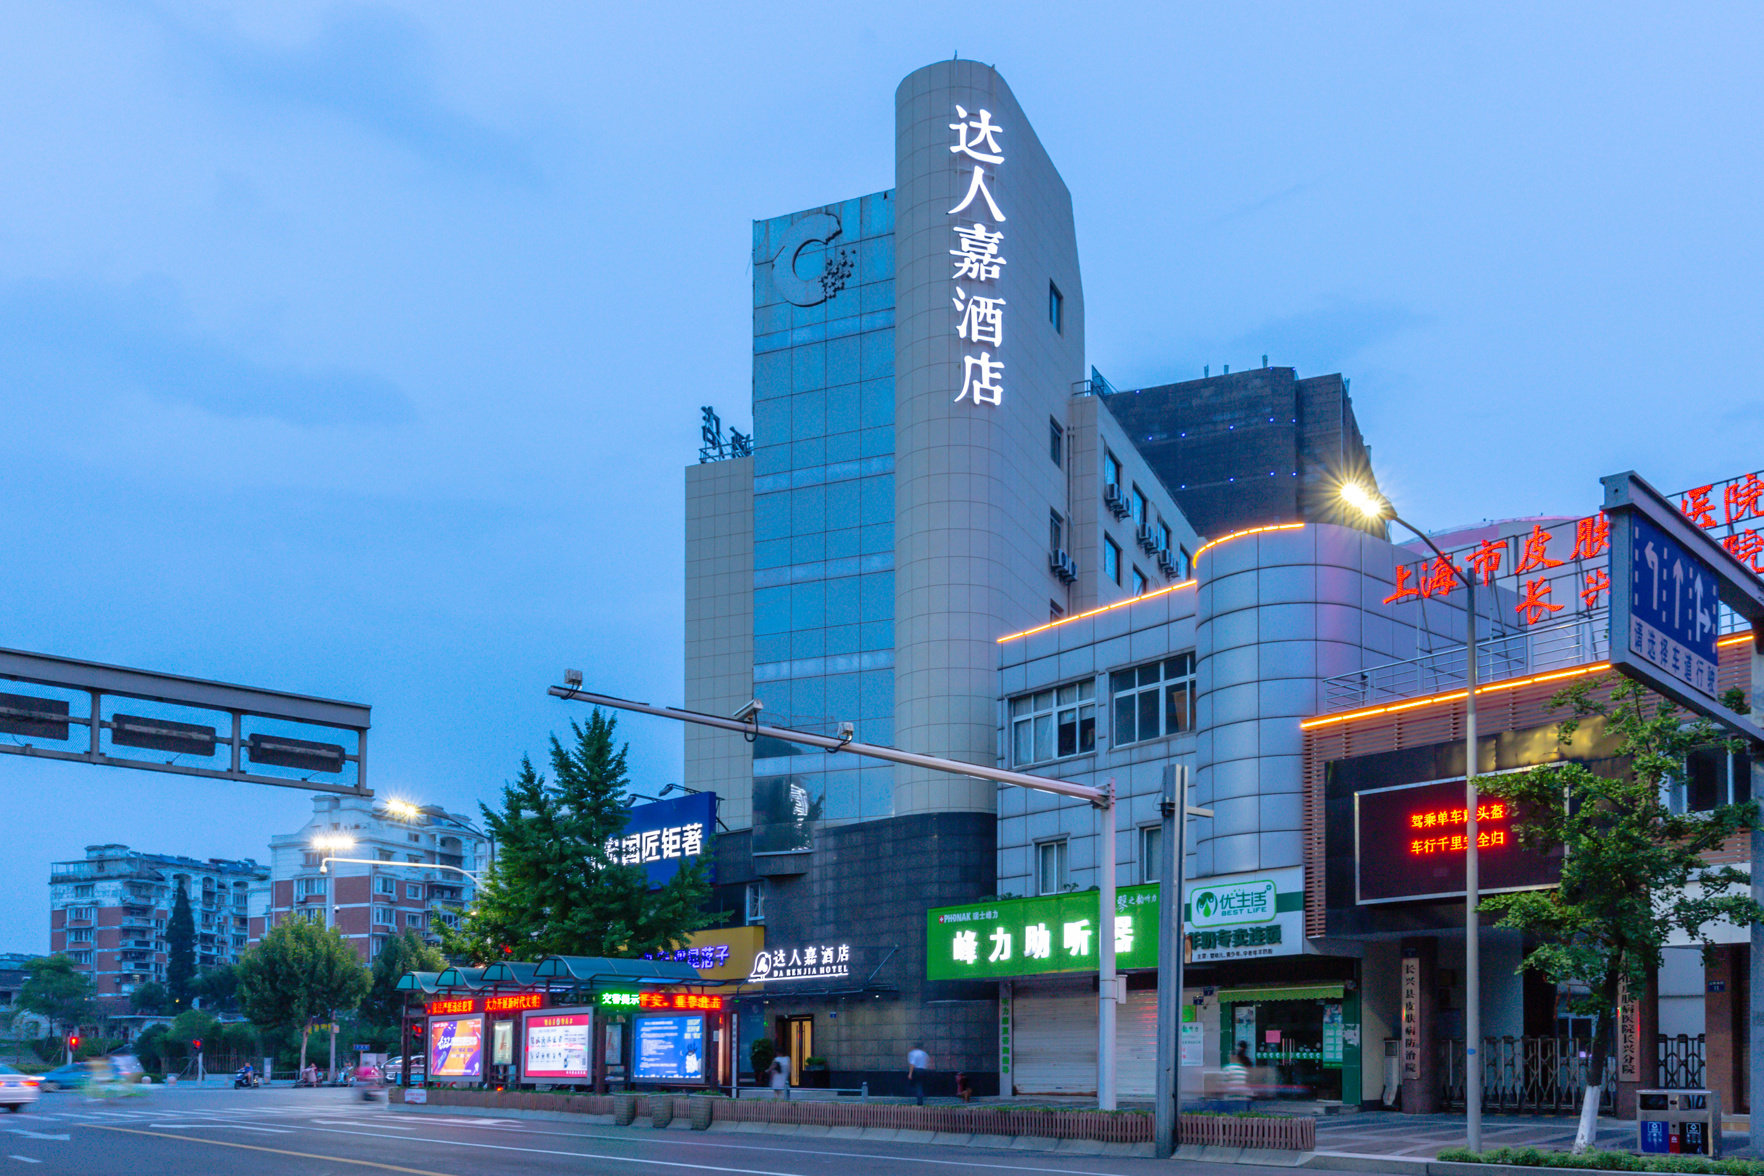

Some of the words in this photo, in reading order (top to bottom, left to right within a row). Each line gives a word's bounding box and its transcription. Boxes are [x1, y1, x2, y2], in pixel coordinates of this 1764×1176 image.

[947, 104, 1007, 407] 达人嘉酒店
[1219, 889, 1268, 909] 优生活
[944, 912, 971, 923] PHONAK
[972, 910, 998, 921] 瑞士峰力
[952, 915, 1135, 965] 峰力助听器
[773, 944, 850, 968] 达人嘉酒店
[773, 969, 784, 977] DA
[786, 967, 817, 976] RENJIA
[819, 964, 848, 974] HOTEL
[1404, 964, 1416, 1073] 长兴县皮肤病防治院
